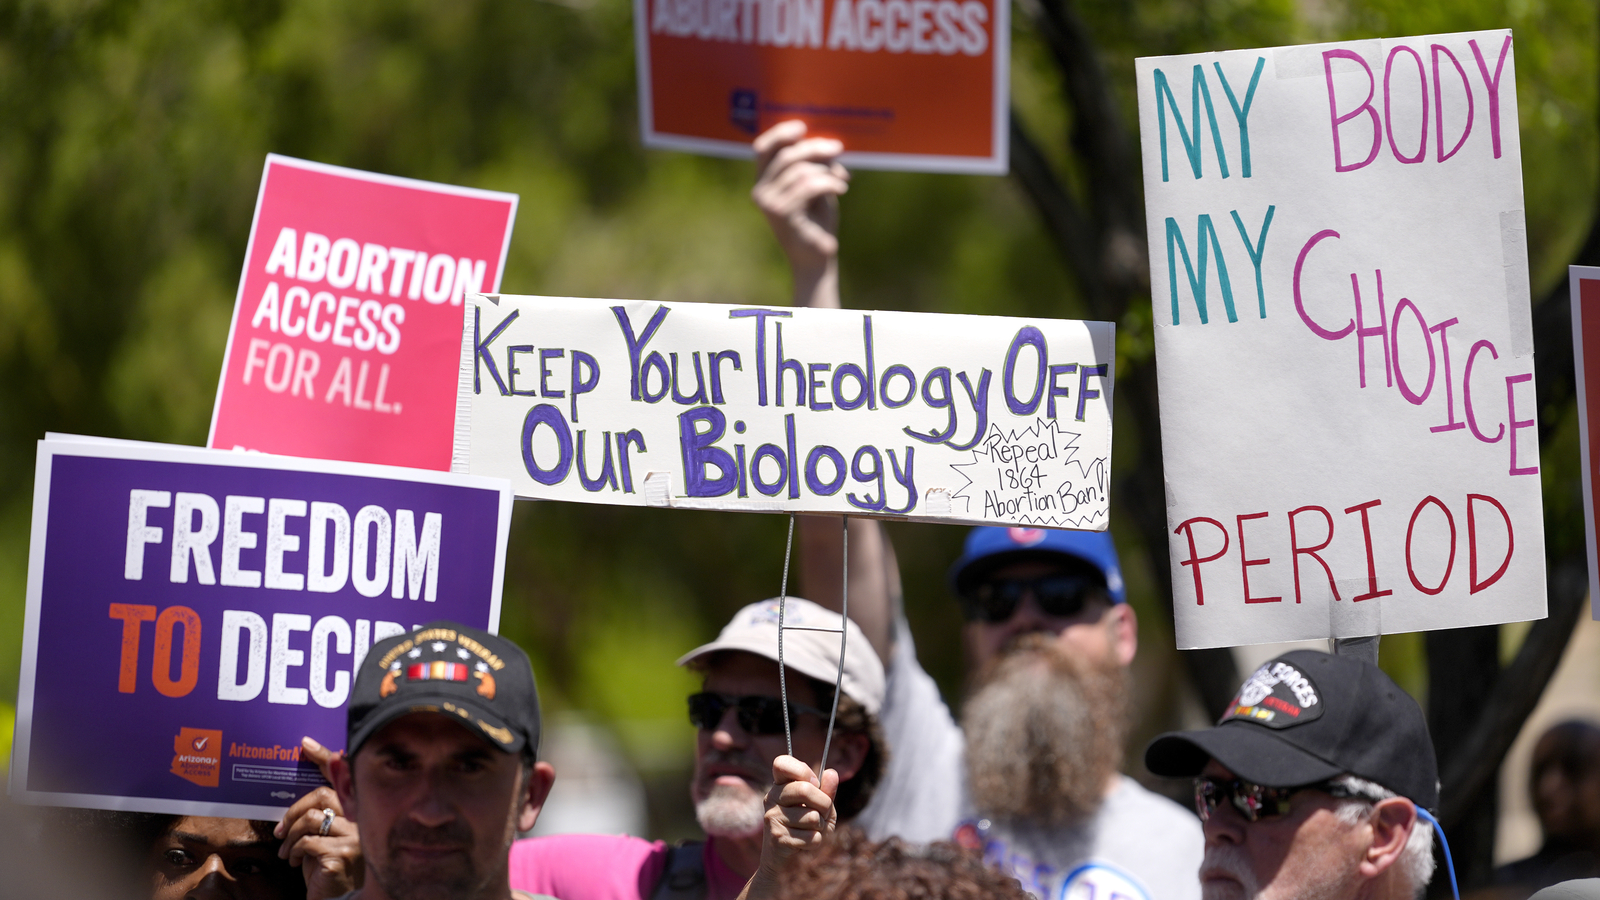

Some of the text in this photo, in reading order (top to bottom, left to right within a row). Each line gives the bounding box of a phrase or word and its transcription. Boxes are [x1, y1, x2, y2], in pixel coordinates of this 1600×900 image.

[652, 0, 988, 55] ABORTION ACCESS
[1154, 36, 1512, 182] MY BODY
[265, 227, 486, 306] ABORTION
[252, 282, 405, 355] ACCESS
[1165, 205, 1538, 476] MY CHOICE
[243, 338, 402, 414] FOR ALL.
[610, 304, 743, 404] Your
[1003, 325, 1108, 421] OFF
[521, 403, 918, 514] Our Biology
[982, 424, 1057, 472] Repeal
[998, 463, 1047, 490] 1864
[983, 461, 1105, 518] Abortion Ban!
[124, 488, 442, 602] FREEDOM
[1174, 493, 1514, 606] PERIOD
[108, 602, 424, 708] TO DECI
[1270, 662, 1318, 708] FORCES
[179, 755, 211, 764] Arizona
